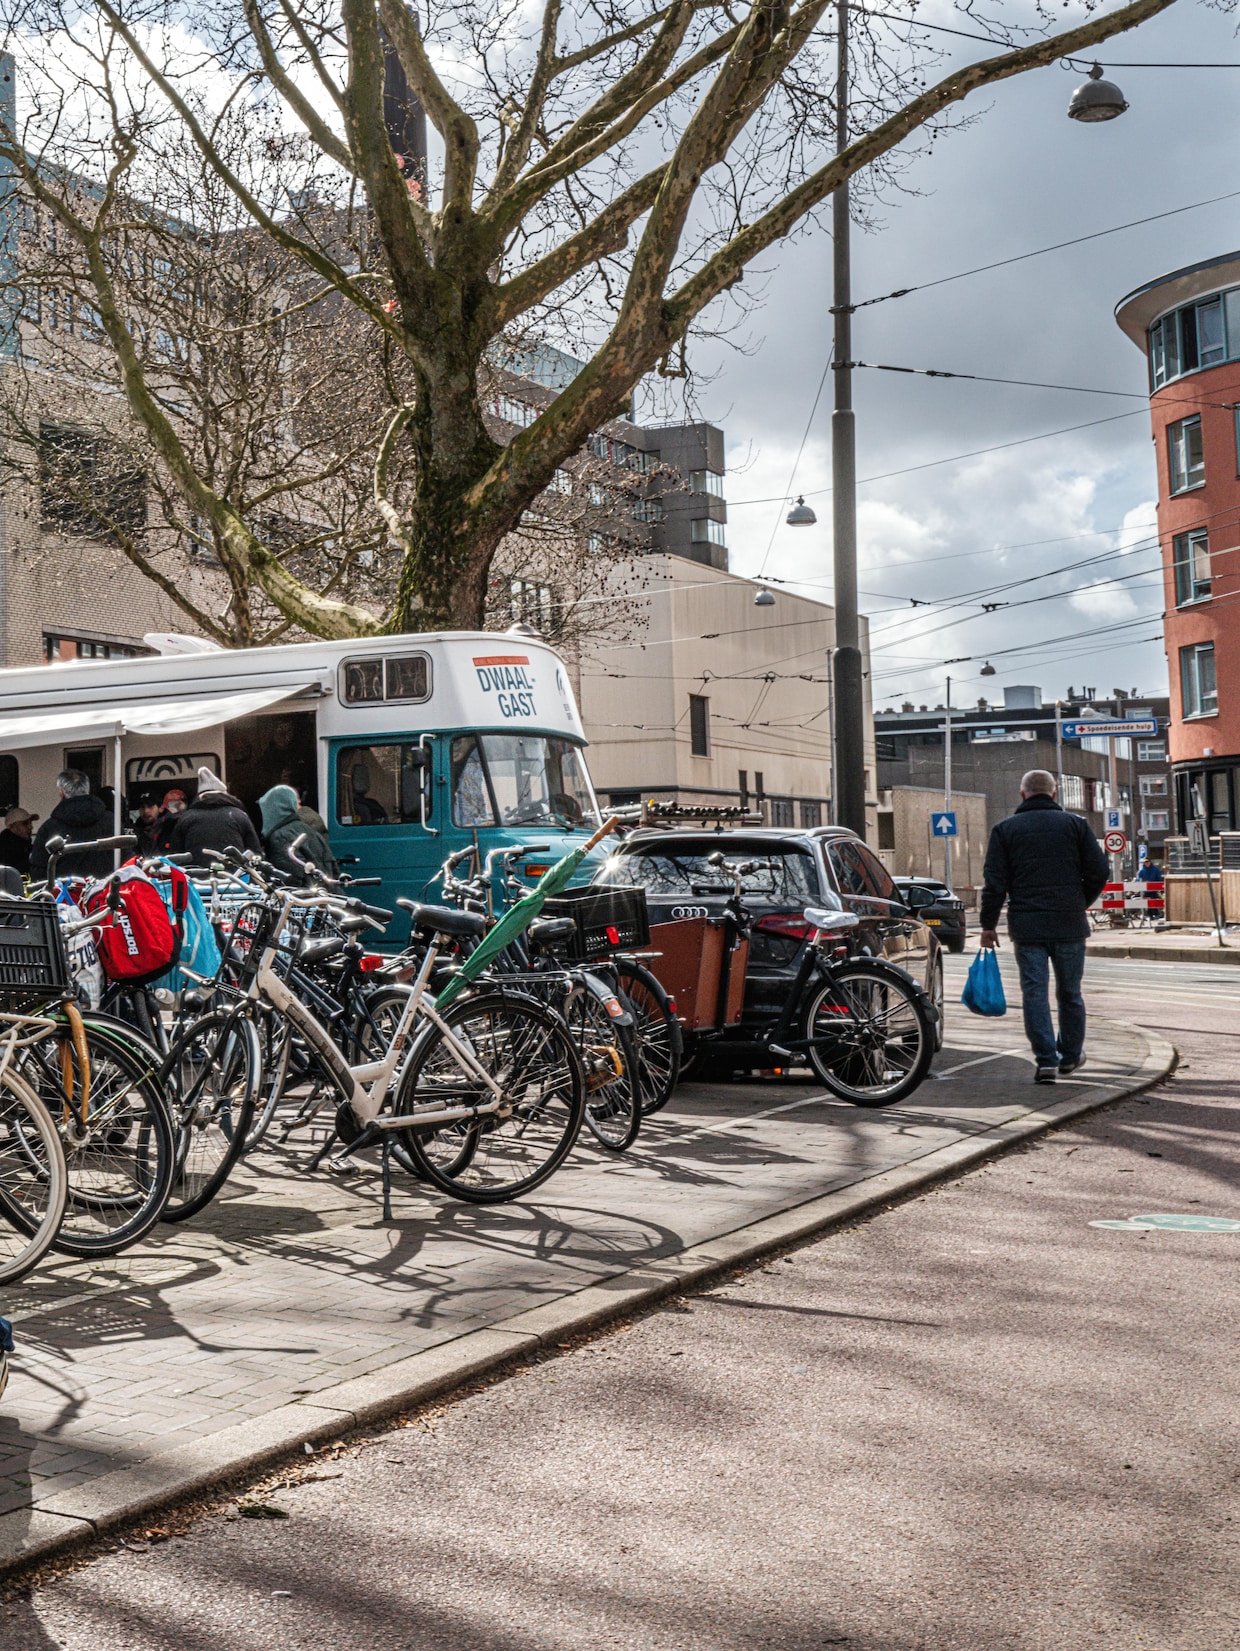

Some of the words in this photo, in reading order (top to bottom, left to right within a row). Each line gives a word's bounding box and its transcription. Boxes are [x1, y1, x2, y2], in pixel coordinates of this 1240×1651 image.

[476, 667, 536, 692] DWAAL-
[498, 692, 537, 718] GAST
[1087, 724, 1134, 732] Spoedeisende
[1108, 838, 1123, 847] 30
[119, 914, 139, 956] Borsch
